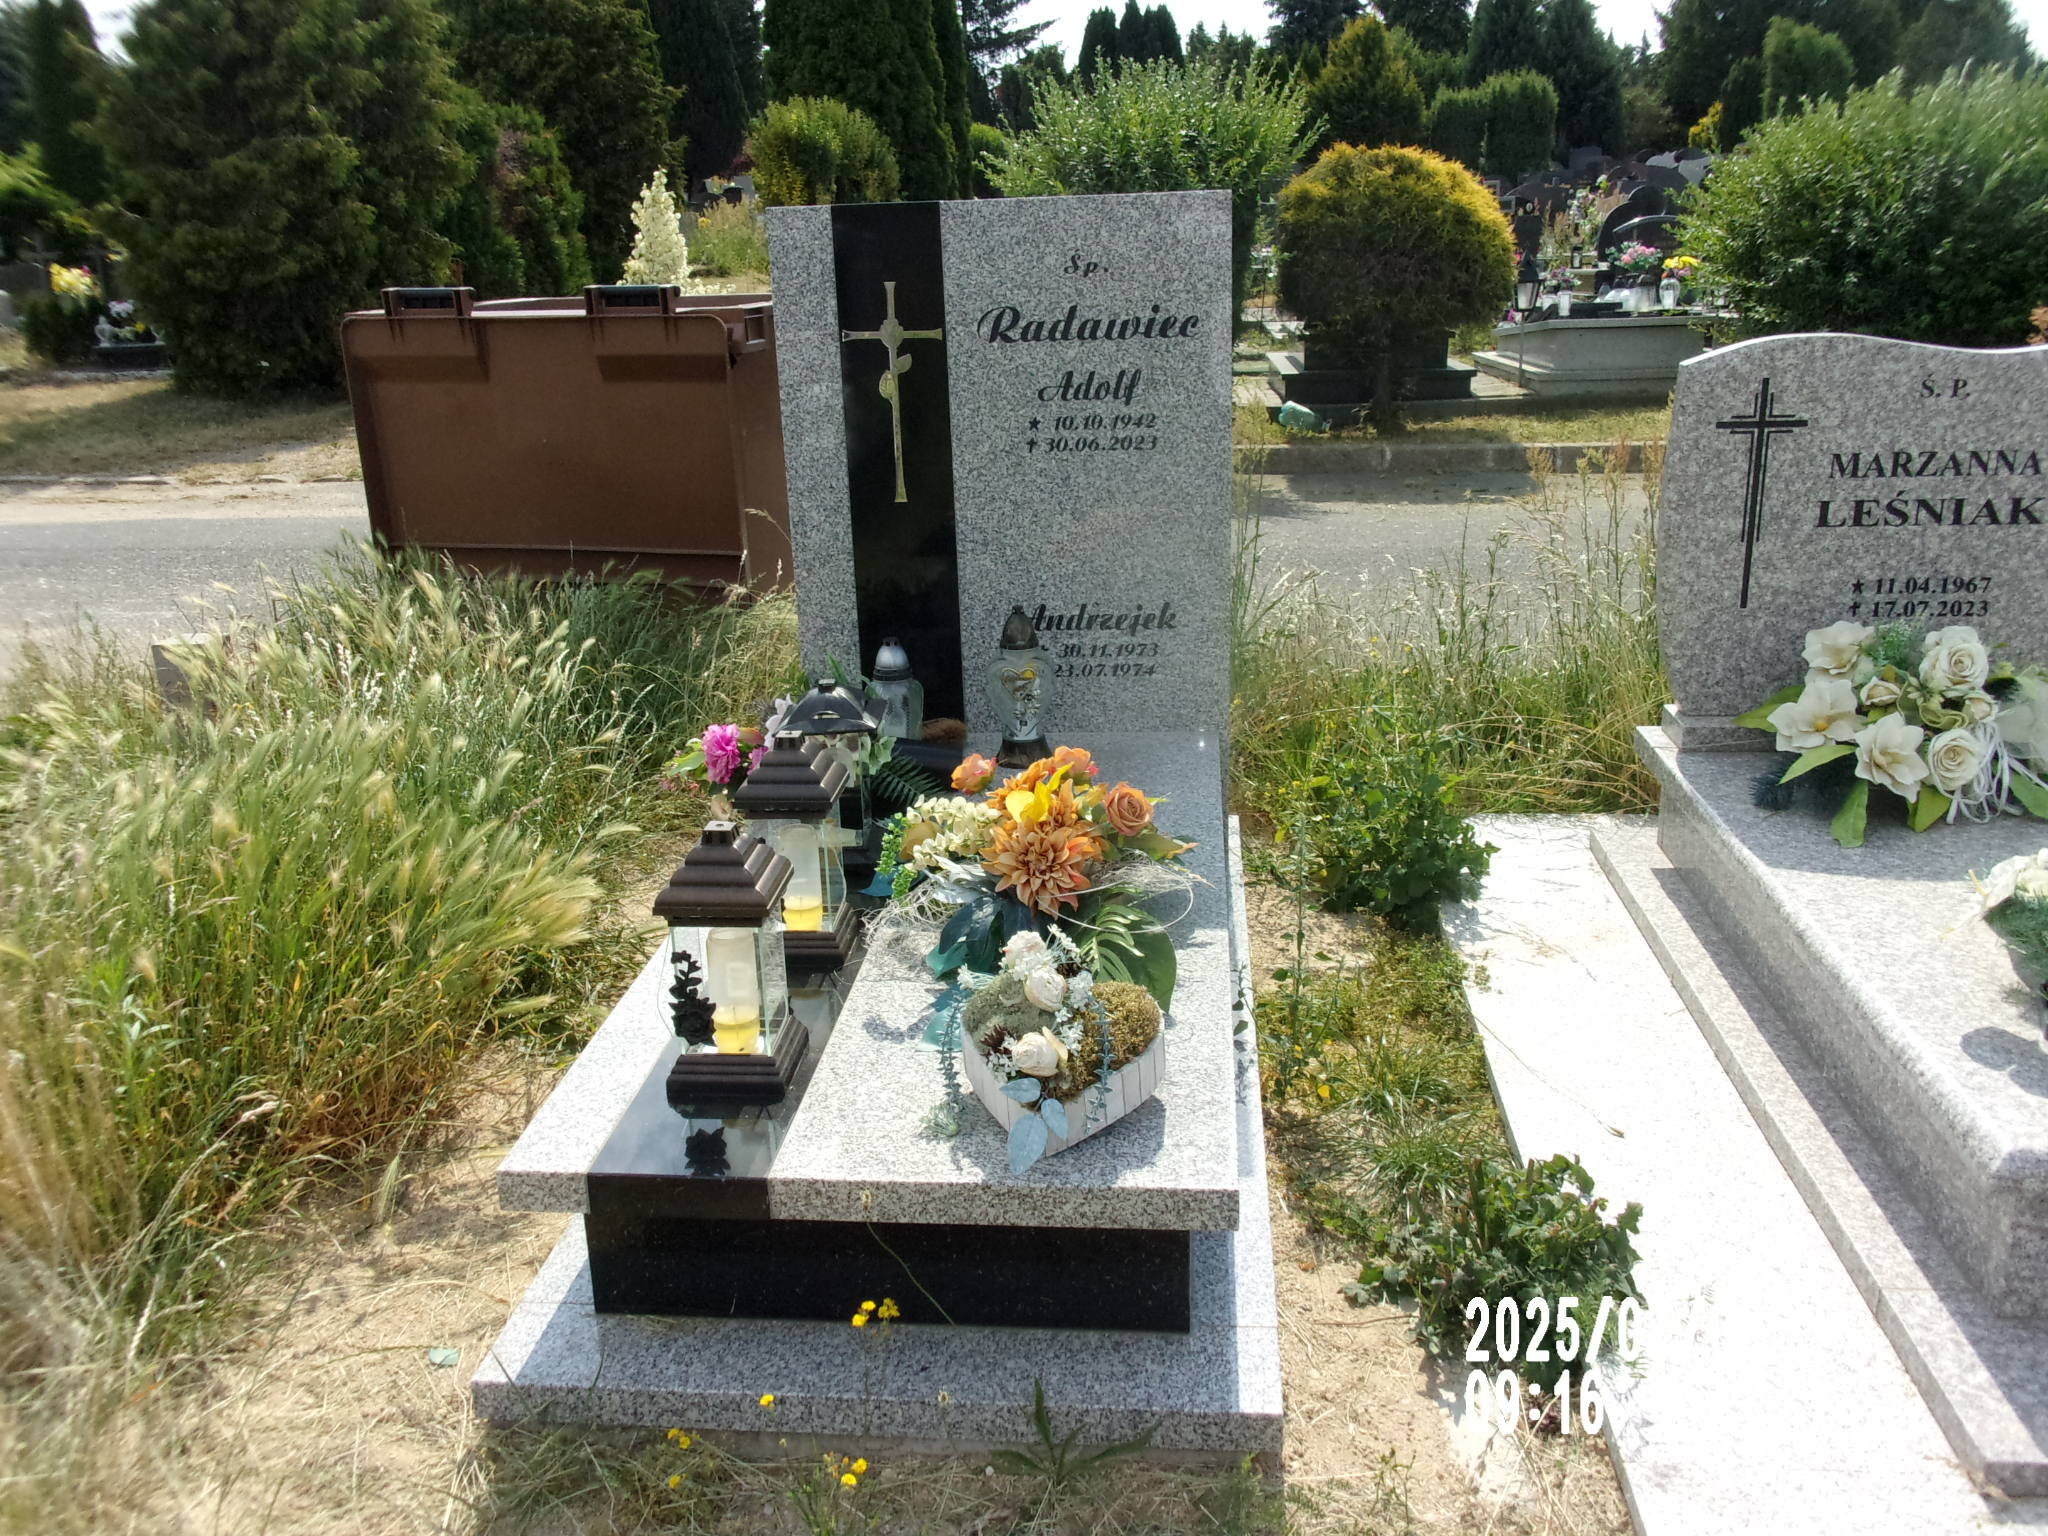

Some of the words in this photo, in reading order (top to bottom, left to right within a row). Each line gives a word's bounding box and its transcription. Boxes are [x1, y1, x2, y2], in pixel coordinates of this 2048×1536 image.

[976, 303, 1200, 344] Radawiec
[1038, 369, 1142, 406] Adolf
[1054, 412, 1157, 431] 10.10.1942
[1044, 434, 1158, 453] 30.06.2023
[1829, 449, 2042, 479] MARZANNA
[1815, 489, 2046, 529] LEŚNIAK
[1875, 576, 1992, 595] 11.04.1967
[1871, 599, 1989, 618] 17.07.2023
[1055, 642, 1159, 658] 30.11.1973
[1054, 663, 1158, 678] 23.07.1974
